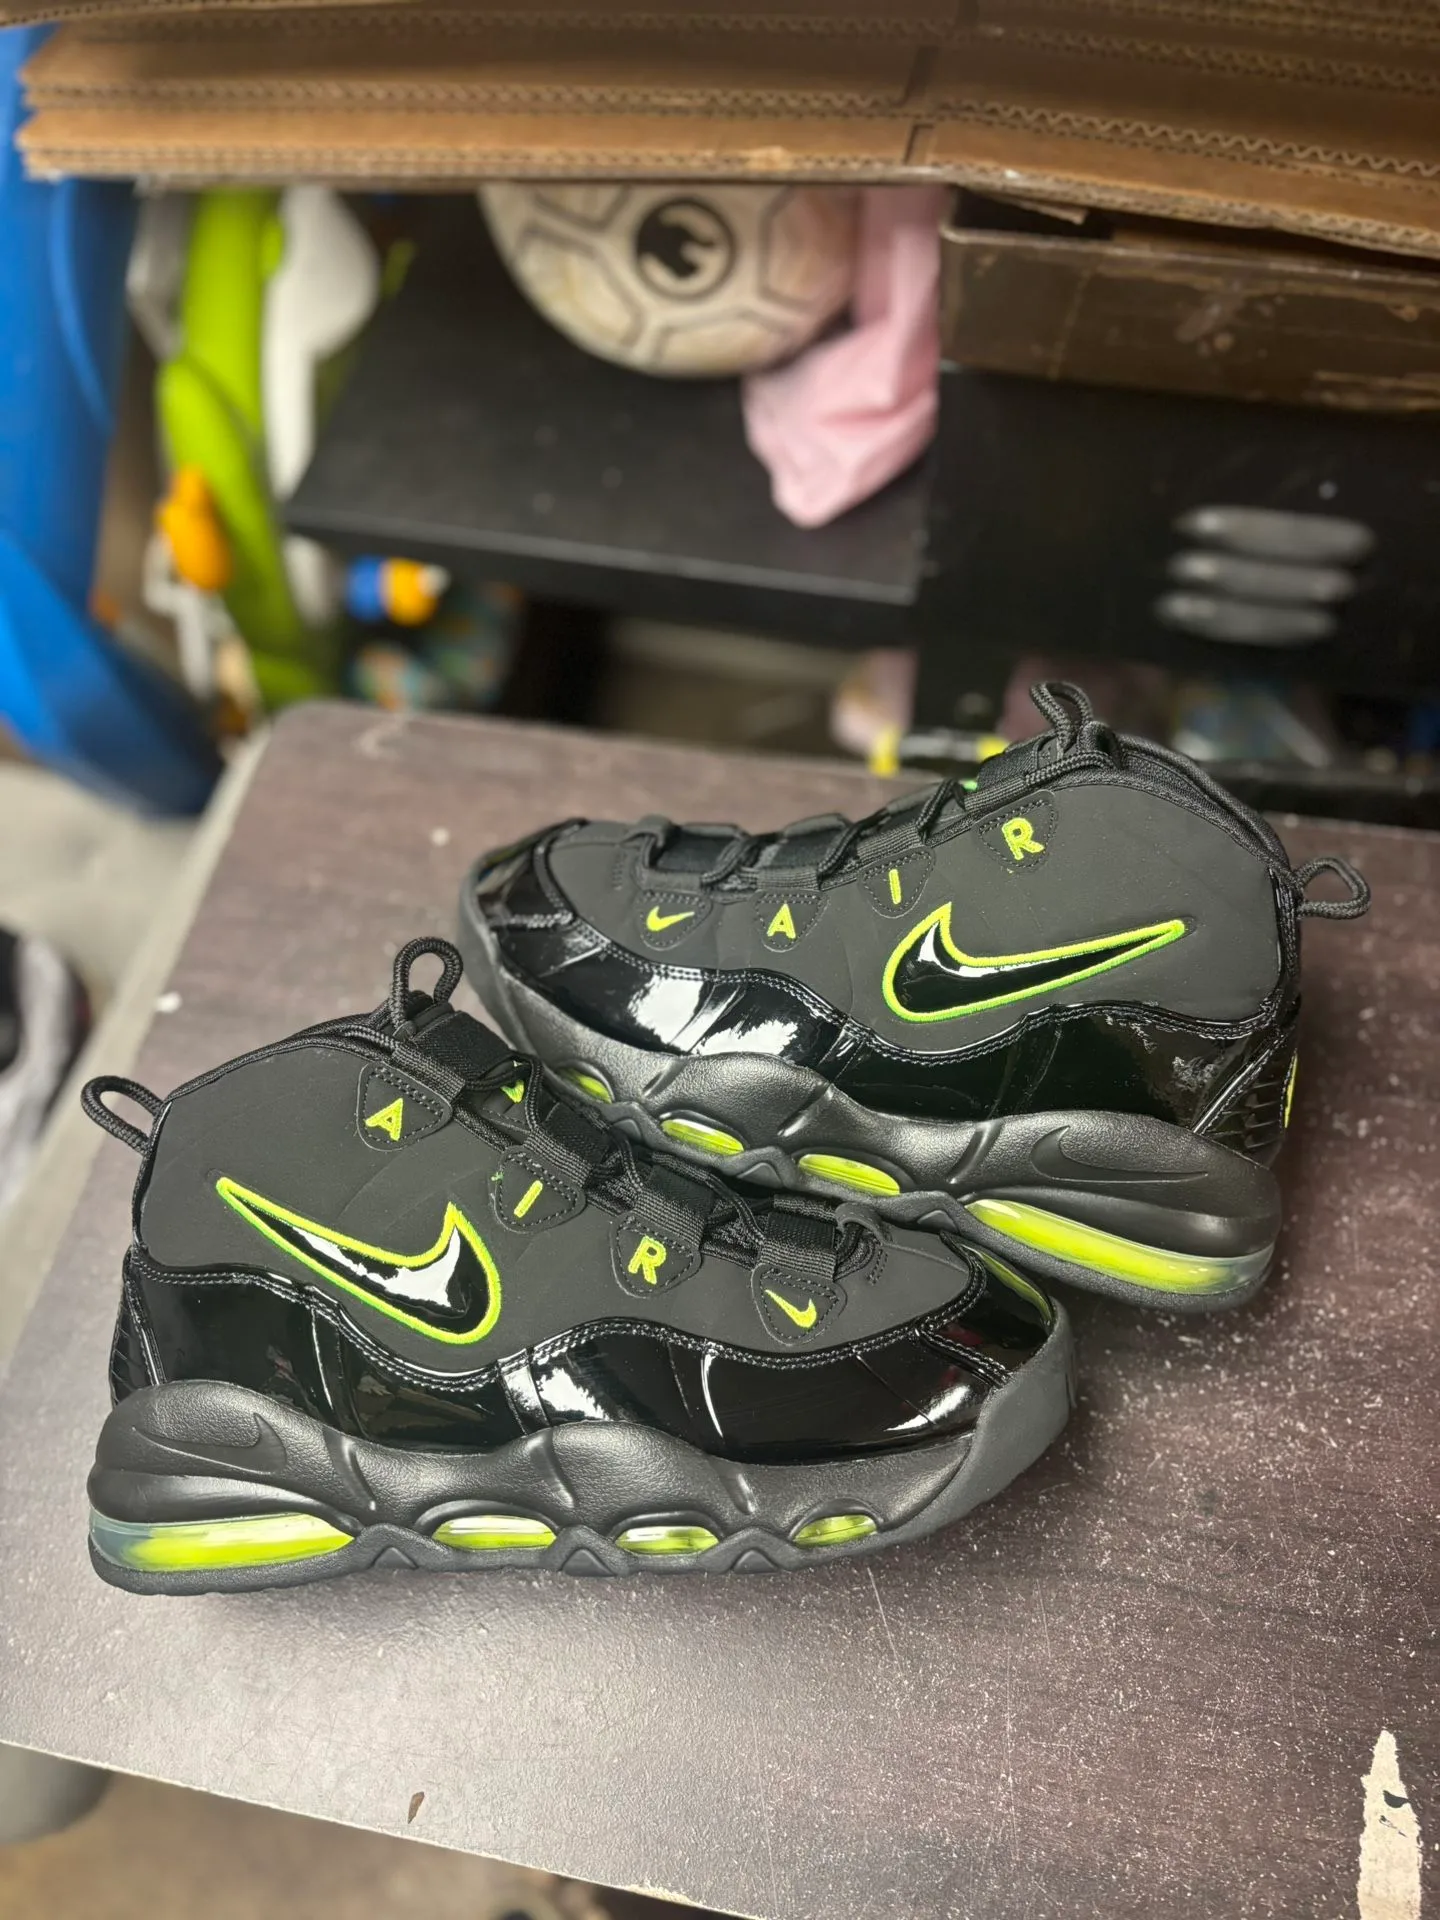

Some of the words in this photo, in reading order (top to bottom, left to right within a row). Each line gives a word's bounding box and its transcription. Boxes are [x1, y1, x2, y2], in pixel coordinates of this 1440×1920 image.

[767, 904, 796, 938] A
[888, 869, 902, 905] I
[1002, 817, 1045, 860] R
[365, 1098, 404, 1141] A
[513, 1180, 544, 1218] I
[628, 1236, 667, 1285] R
